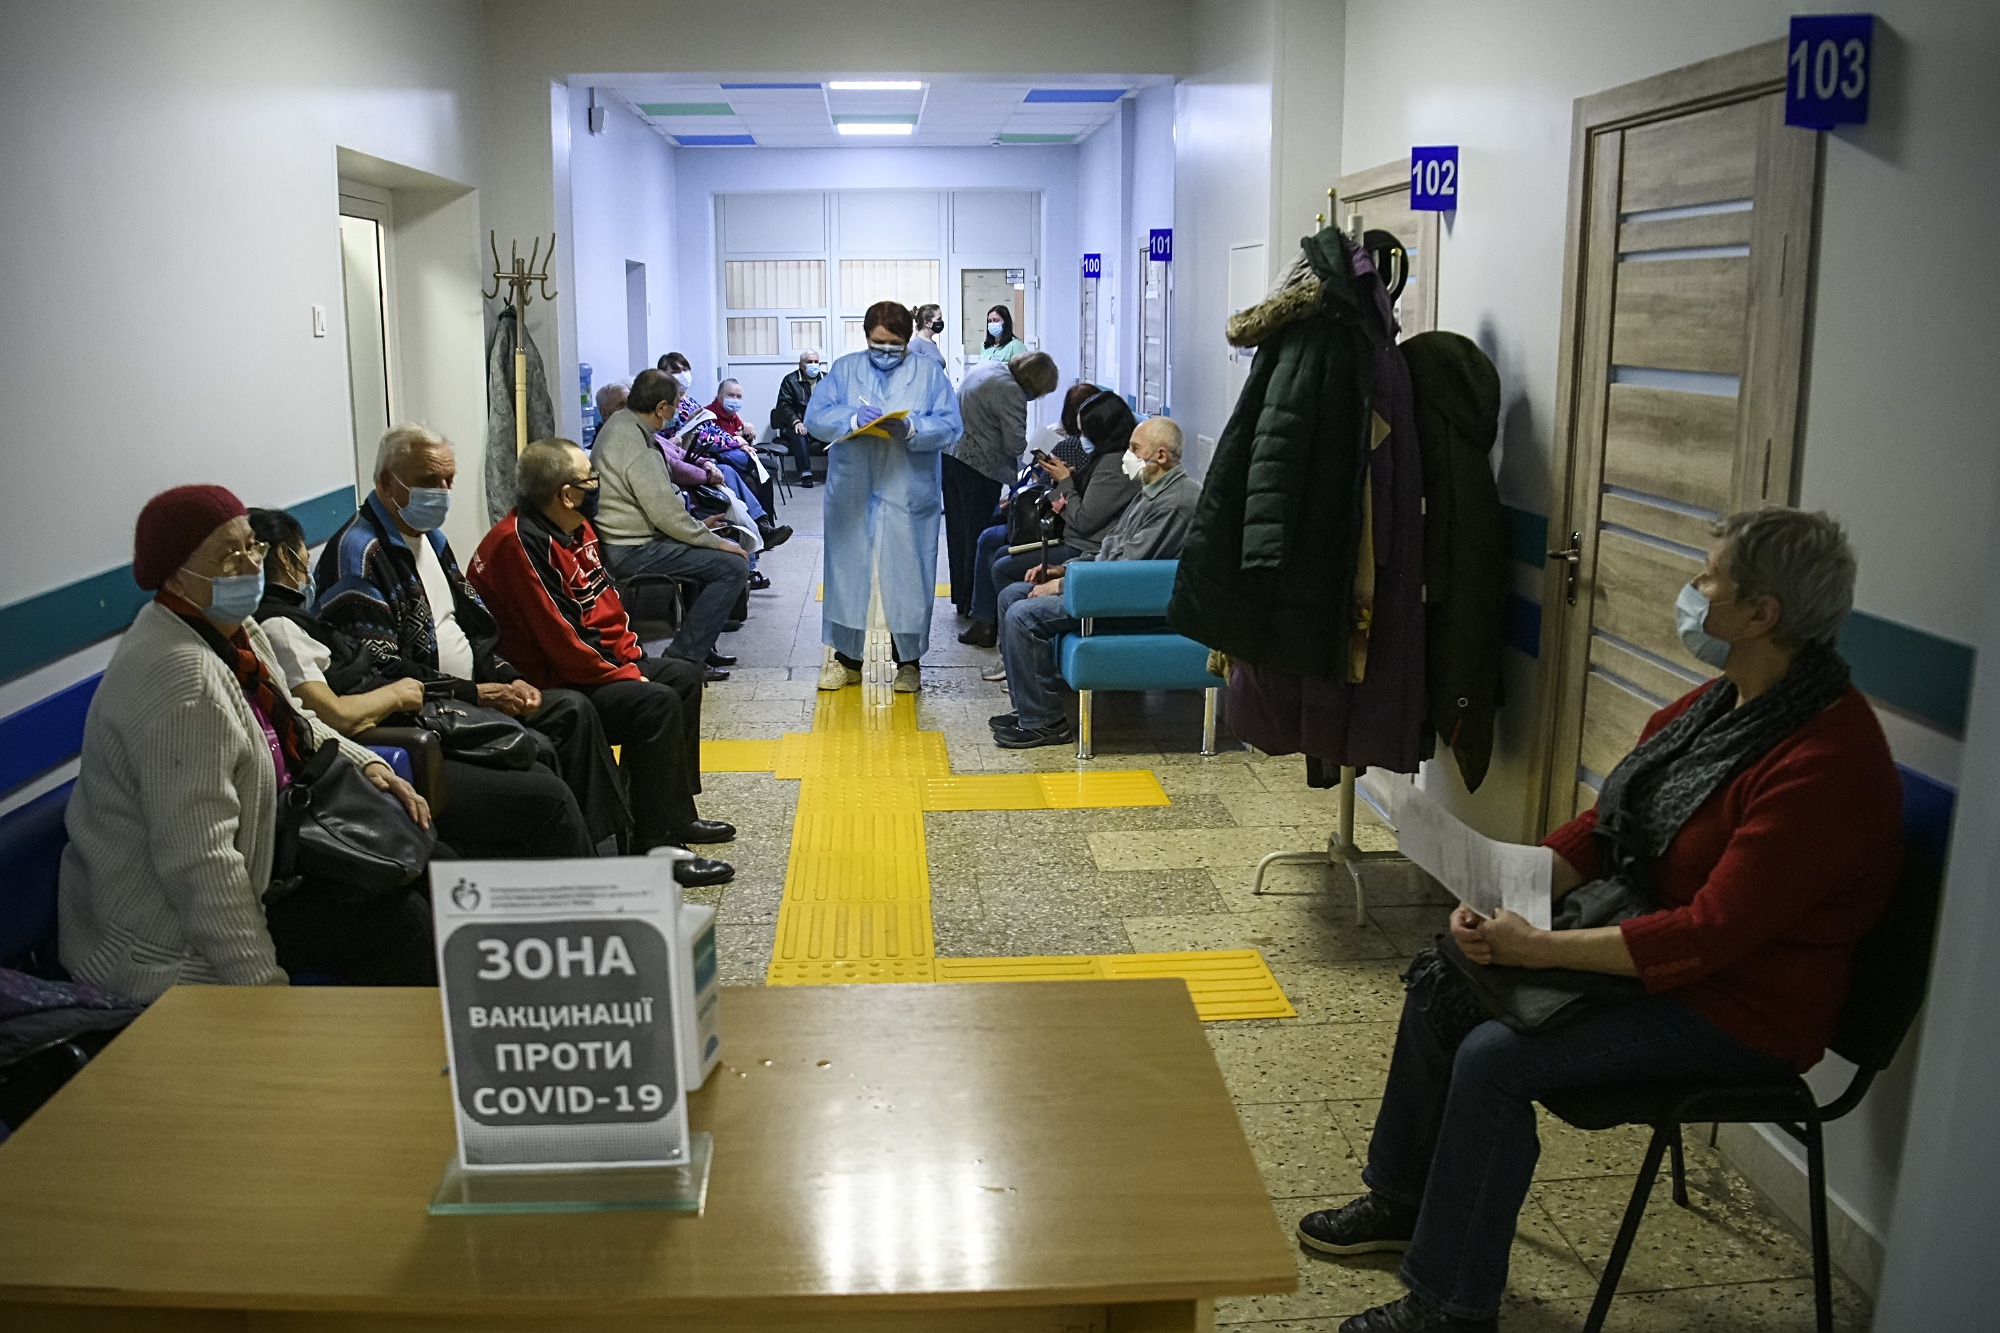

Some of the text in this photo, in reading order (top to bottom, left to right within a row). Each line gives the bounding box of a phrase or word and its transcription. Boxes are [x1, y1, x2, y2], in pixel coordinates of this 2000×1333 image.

[1790, 38, 1866, 99] 103
[1412, 159, 1455, 196] 102
[1150, 235, 1170, 254] 101
[1084, 258, 1100, 273] 100
[476, 934, 636, 981] ЗОНА
[468, 997, 654, 1031] ВАКЦИНАЦІЇ
[494, 1039, 633, 1073] ПРОТИ
[473, 1083, 664, 1116] COVID-19
